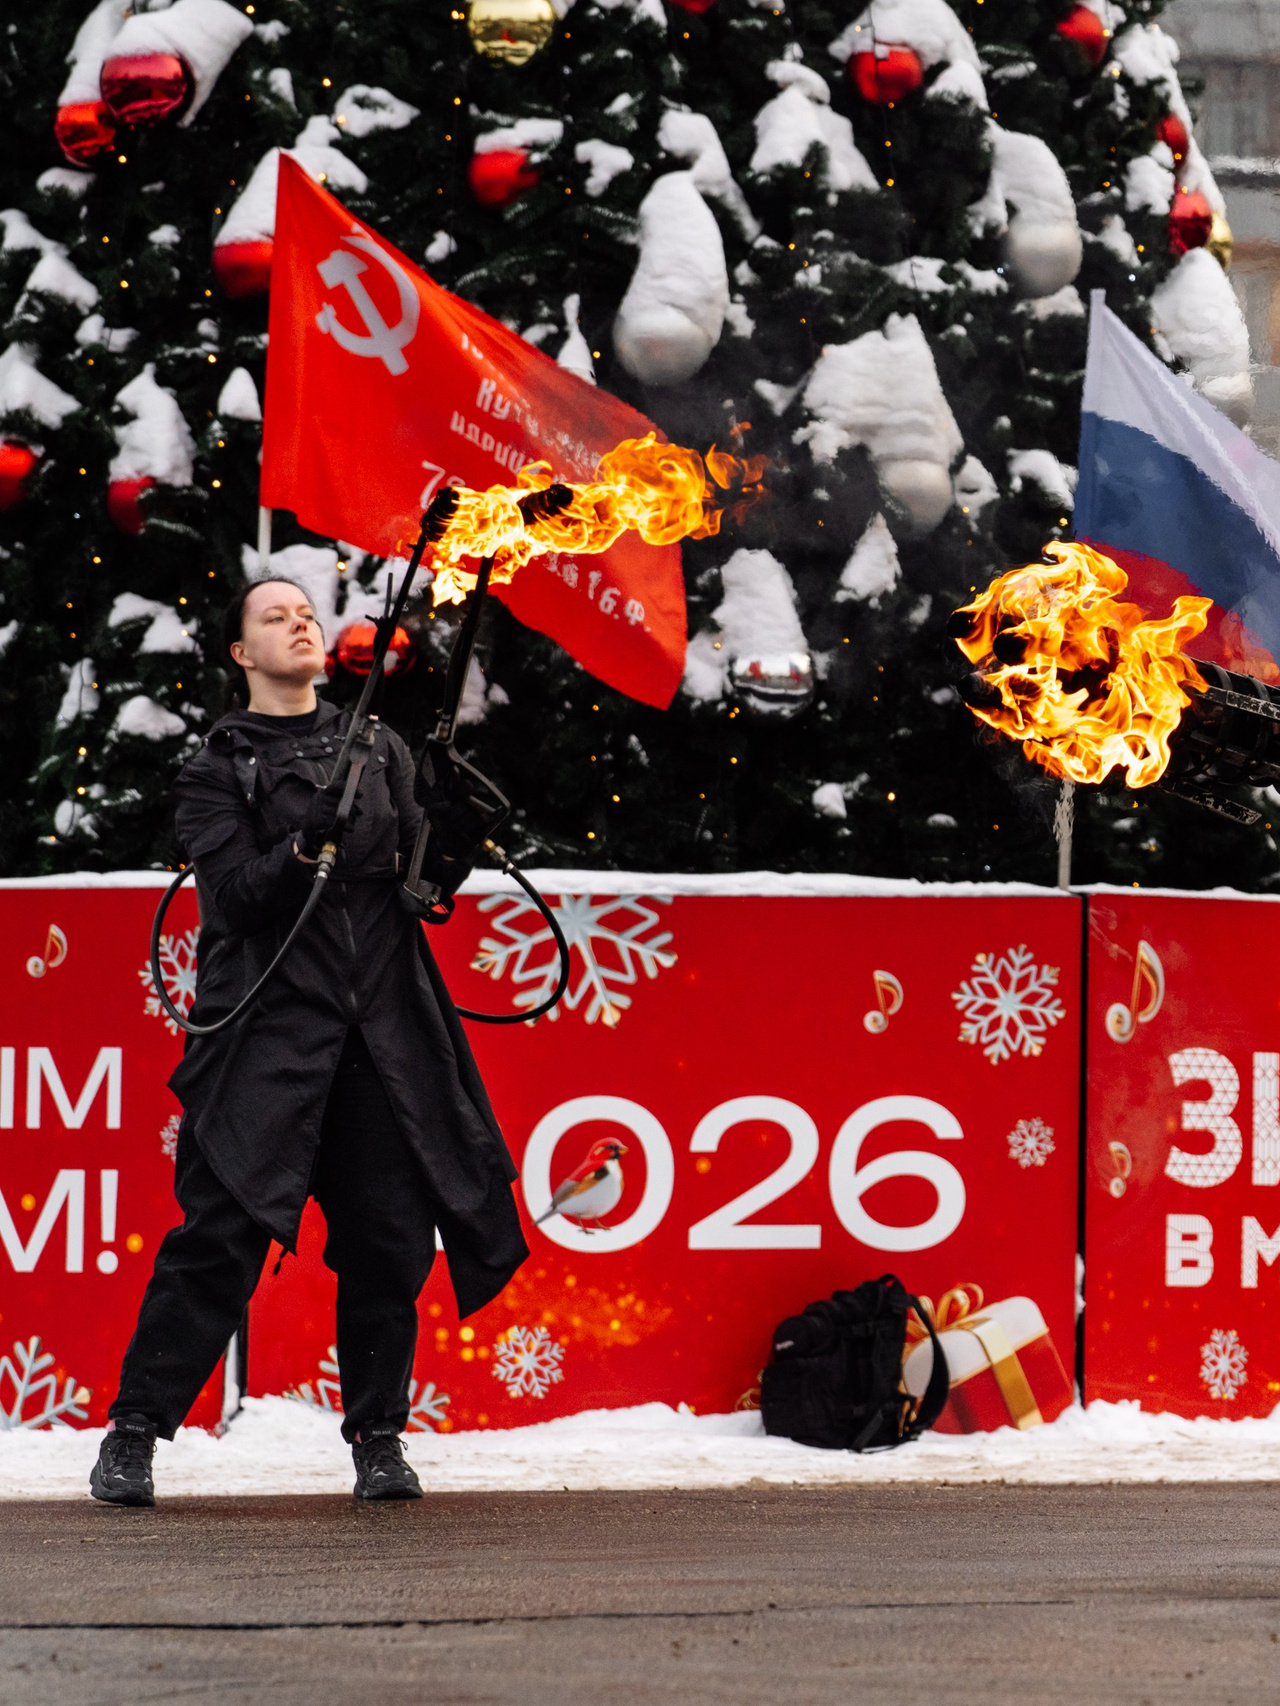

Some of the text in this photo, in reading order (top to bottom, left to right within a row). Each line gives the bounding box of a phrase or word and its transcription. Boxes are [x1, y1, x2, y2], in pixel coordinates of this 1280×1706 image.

[420, 459, 466, 509] 7
[0, 1046, 122, 1129] М
[435, 1095, 967, 1252] 026
[1165, 1213, 1214, 1288] В
